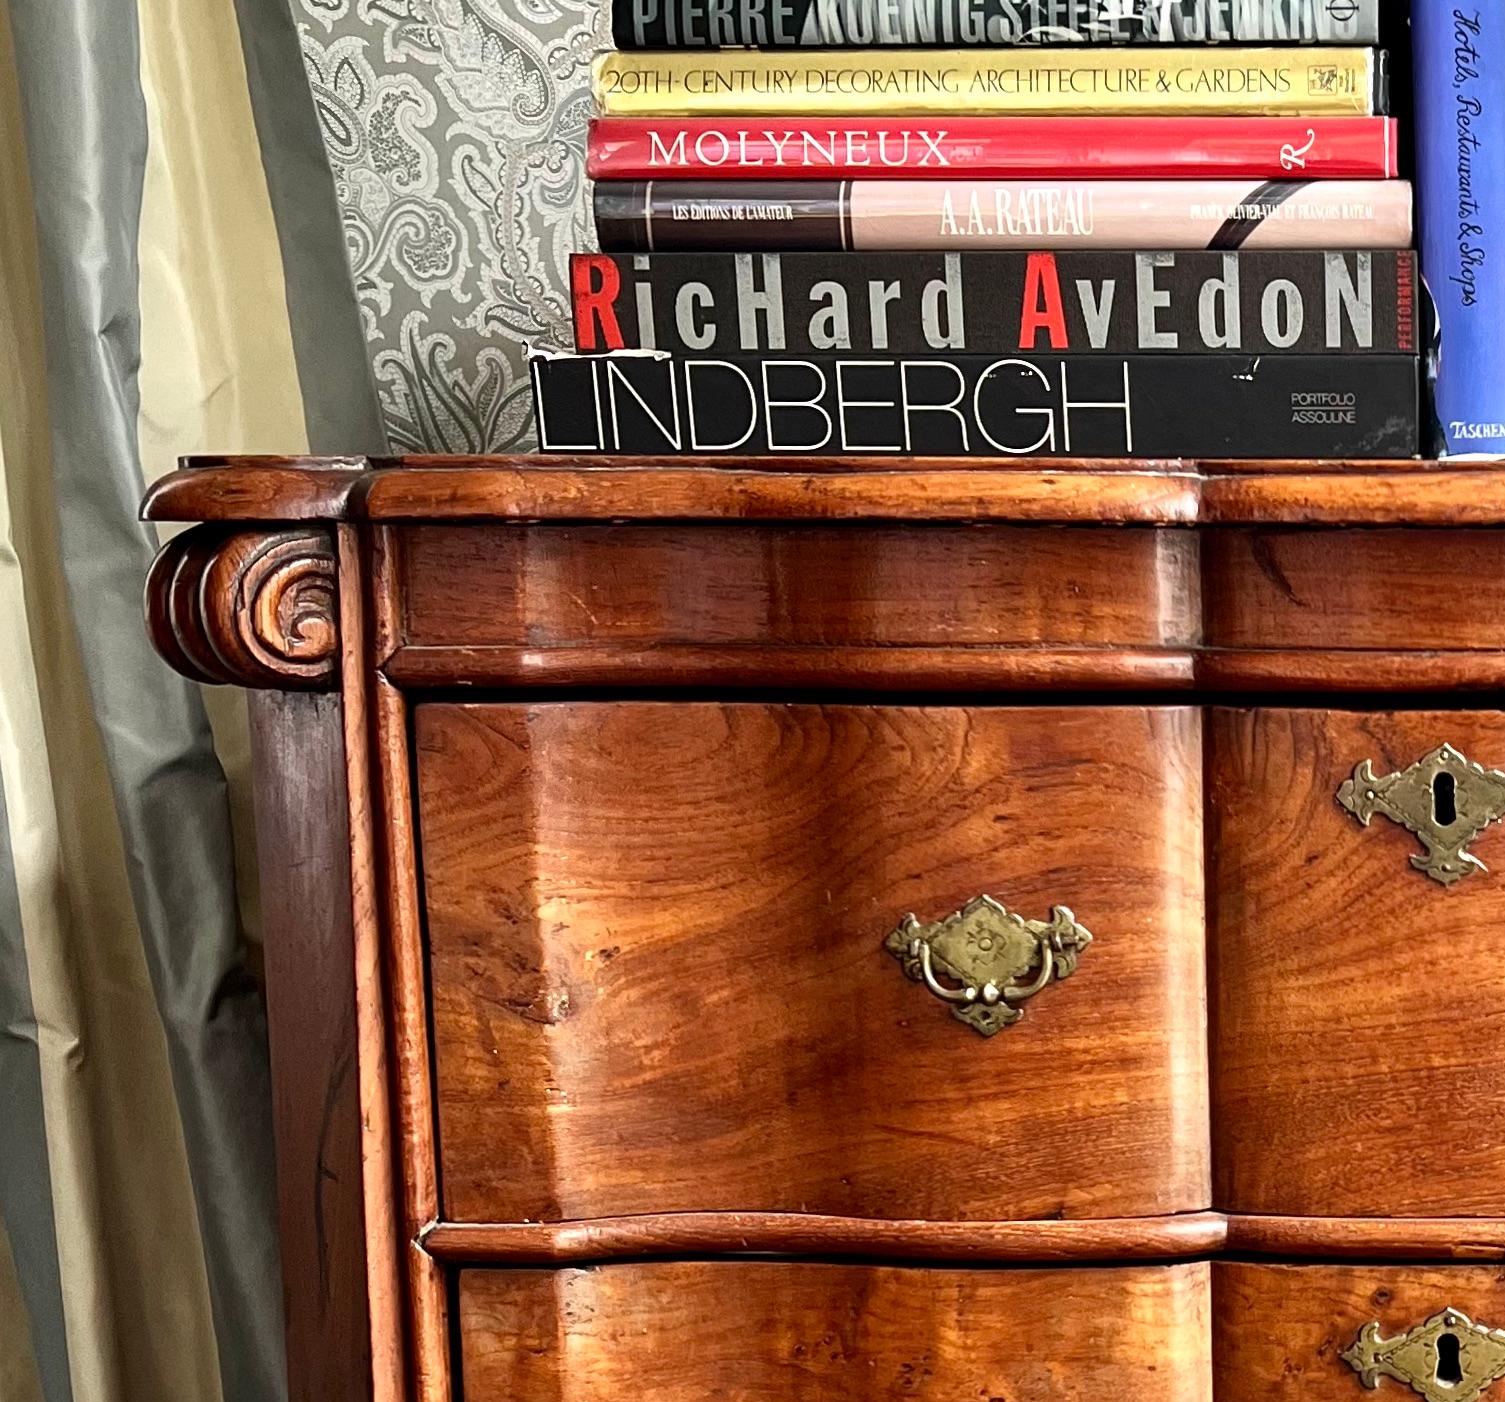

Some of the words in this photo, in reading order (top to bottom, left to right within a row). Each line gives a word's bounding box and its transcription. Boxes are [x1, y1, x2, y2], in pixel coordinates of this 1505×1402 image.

[632, 0, 796, 45] PIERRE
[1453, 9, 1481, 88] Hotels,
[805, 69, 959, 94] DECORATING
[969, 68, 1150, 94] ARCHITECTURE
[1155, 70, 1171, 93] &
[1176, 68, 1290, 93] GARDENS
[646, 130, 951, 166] MOLYNEUX
[1456, 95, 1482, 219] Restaurants
[672, 205, 689, 220] LES
[1457, 222, 1483, 240] &
[1449, 242, 1485, 307] Shops
[533, 359, 1133, 453] LINDBERGH
[1291, 411, 1356, 424] ASSOULINE
